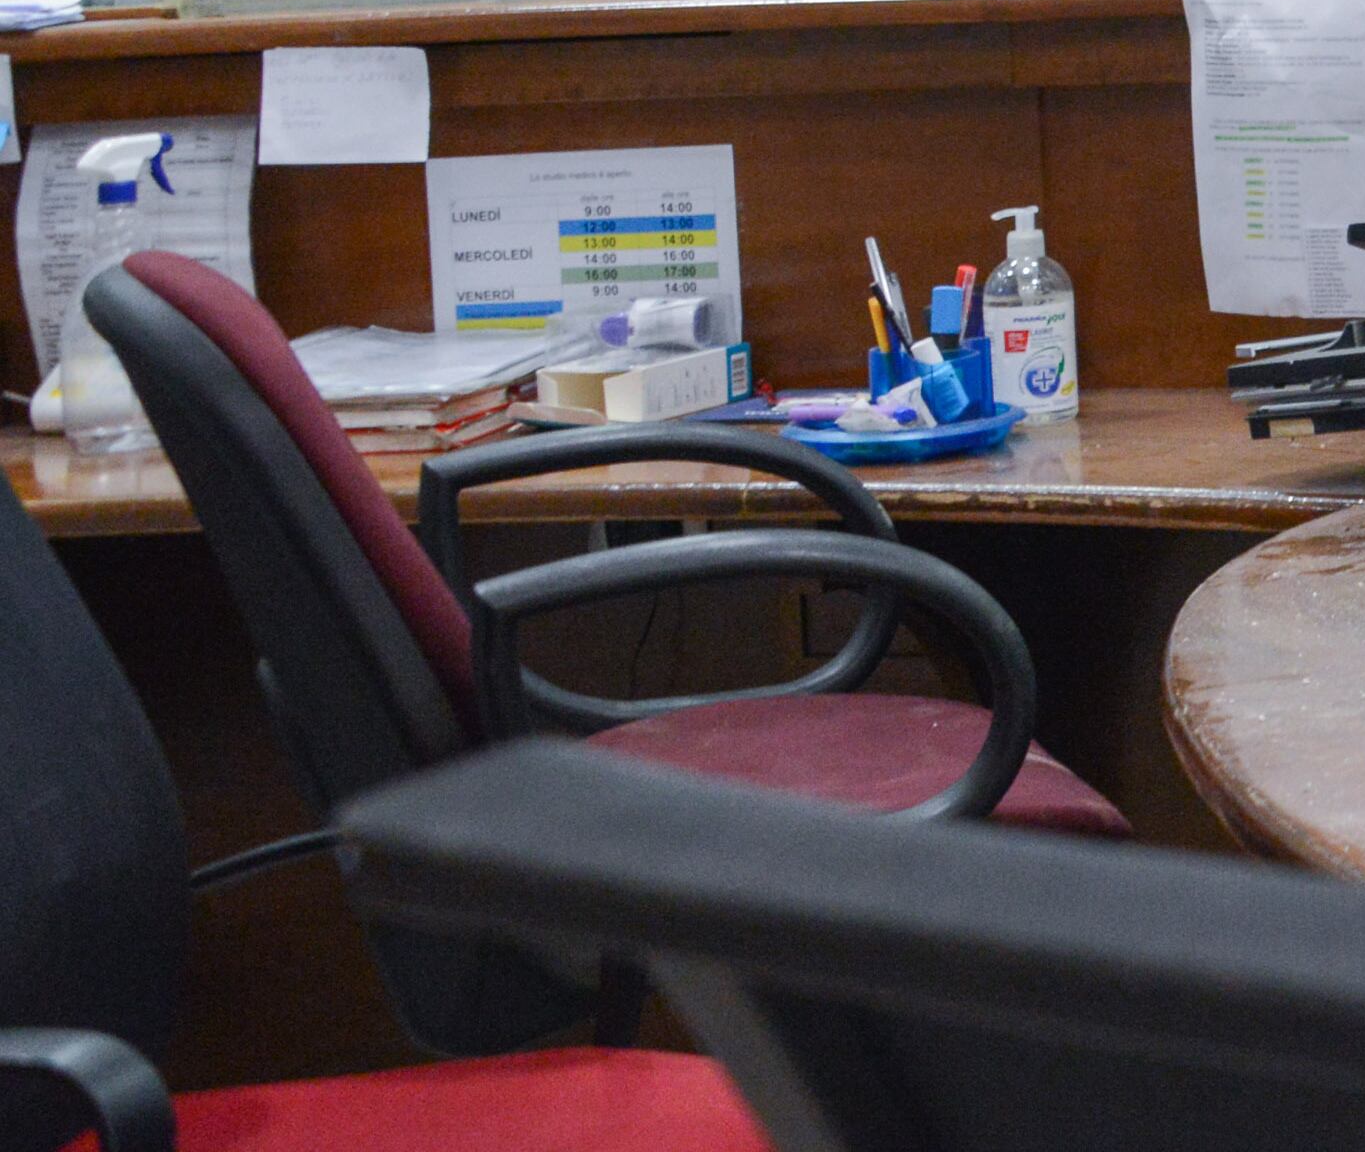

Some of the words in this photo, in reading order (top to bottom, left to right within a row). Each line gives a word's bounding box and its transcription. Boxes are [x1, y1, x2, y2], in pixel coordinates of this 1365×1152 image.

[451, 206, 502, 224] LUNEDÌ
[584, 205, 611, 217] 9:00
[660, 202, 693, 214] 14:00
[583, 220, 616, 233] 12:00
[661, 218, 694, 230] 13:00
[584, 237, 616, 249] 13:00
[662, 234, 694, 246] 14:00
[454, 247, 533, 263] MERCOLEDÌ
[584, 253, 617, 265] 14:00
[663, 250, 695, 262] 16:00
[585, 269, 618, 281] 16:00
[664, 266, 697, 278] 17:00
[456, 289, 515, 303] VENERDÌ
[593, 285, 619, 296] 9:00
[665, 282, 697, 294] 14:00
